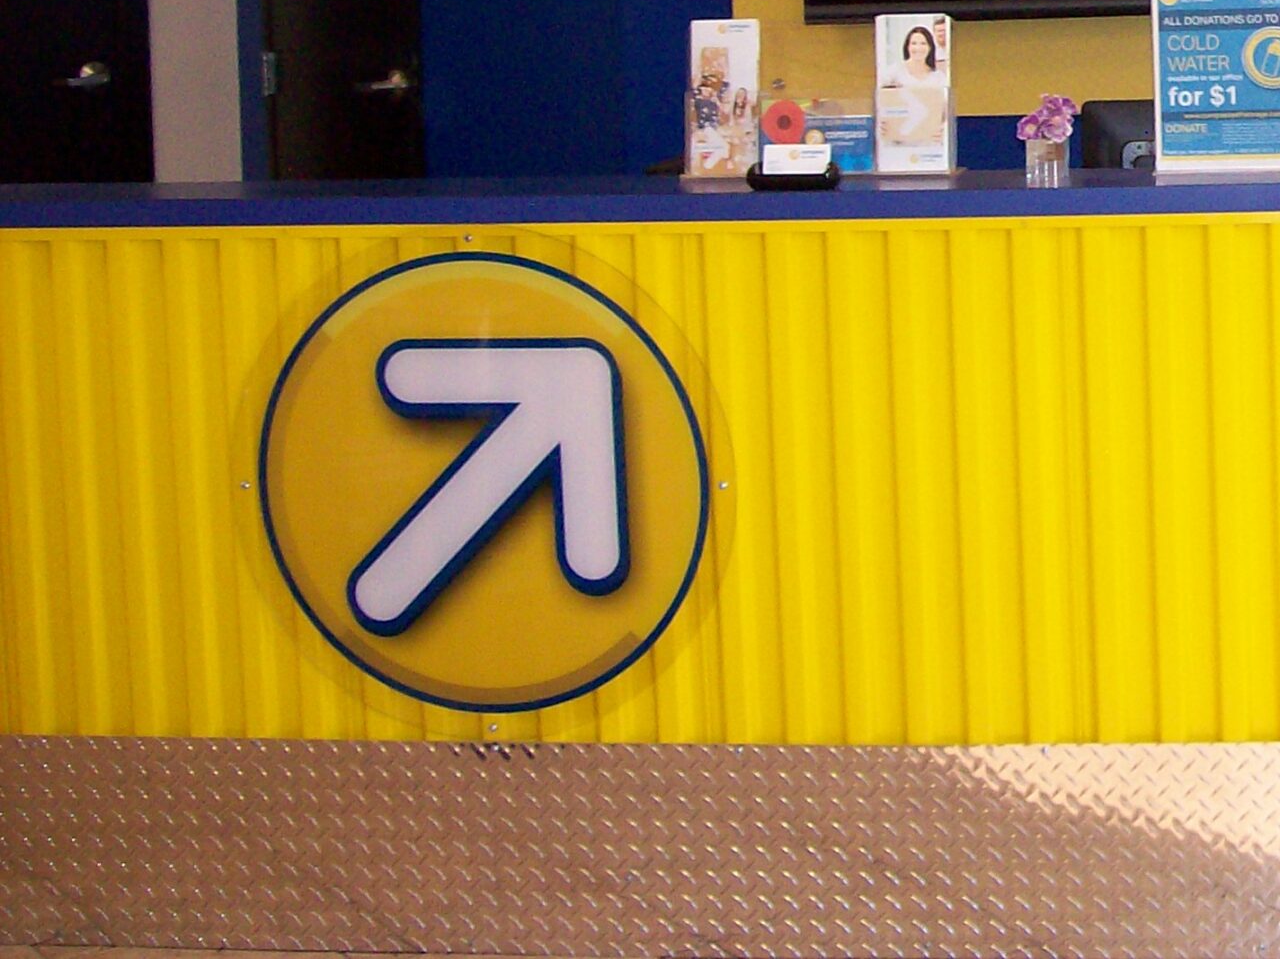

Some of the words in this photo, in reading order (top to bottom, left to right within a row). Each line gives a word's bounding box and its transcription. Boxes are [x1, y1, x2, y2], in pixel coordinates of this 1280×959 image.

[1163, 16, 1182, 26] ALL
[1184, 14, 1245, 26] DONATIONS
[1246, 13, 1263, 24] GO
[1264, 13, 1279, 24] TO
[1167, 33, 1220, 52] COLD
[1167, 54, 1230, 72] WATER
[1168, 85, 1204, 107] for
[1209, 84, 1238, 108] $1
